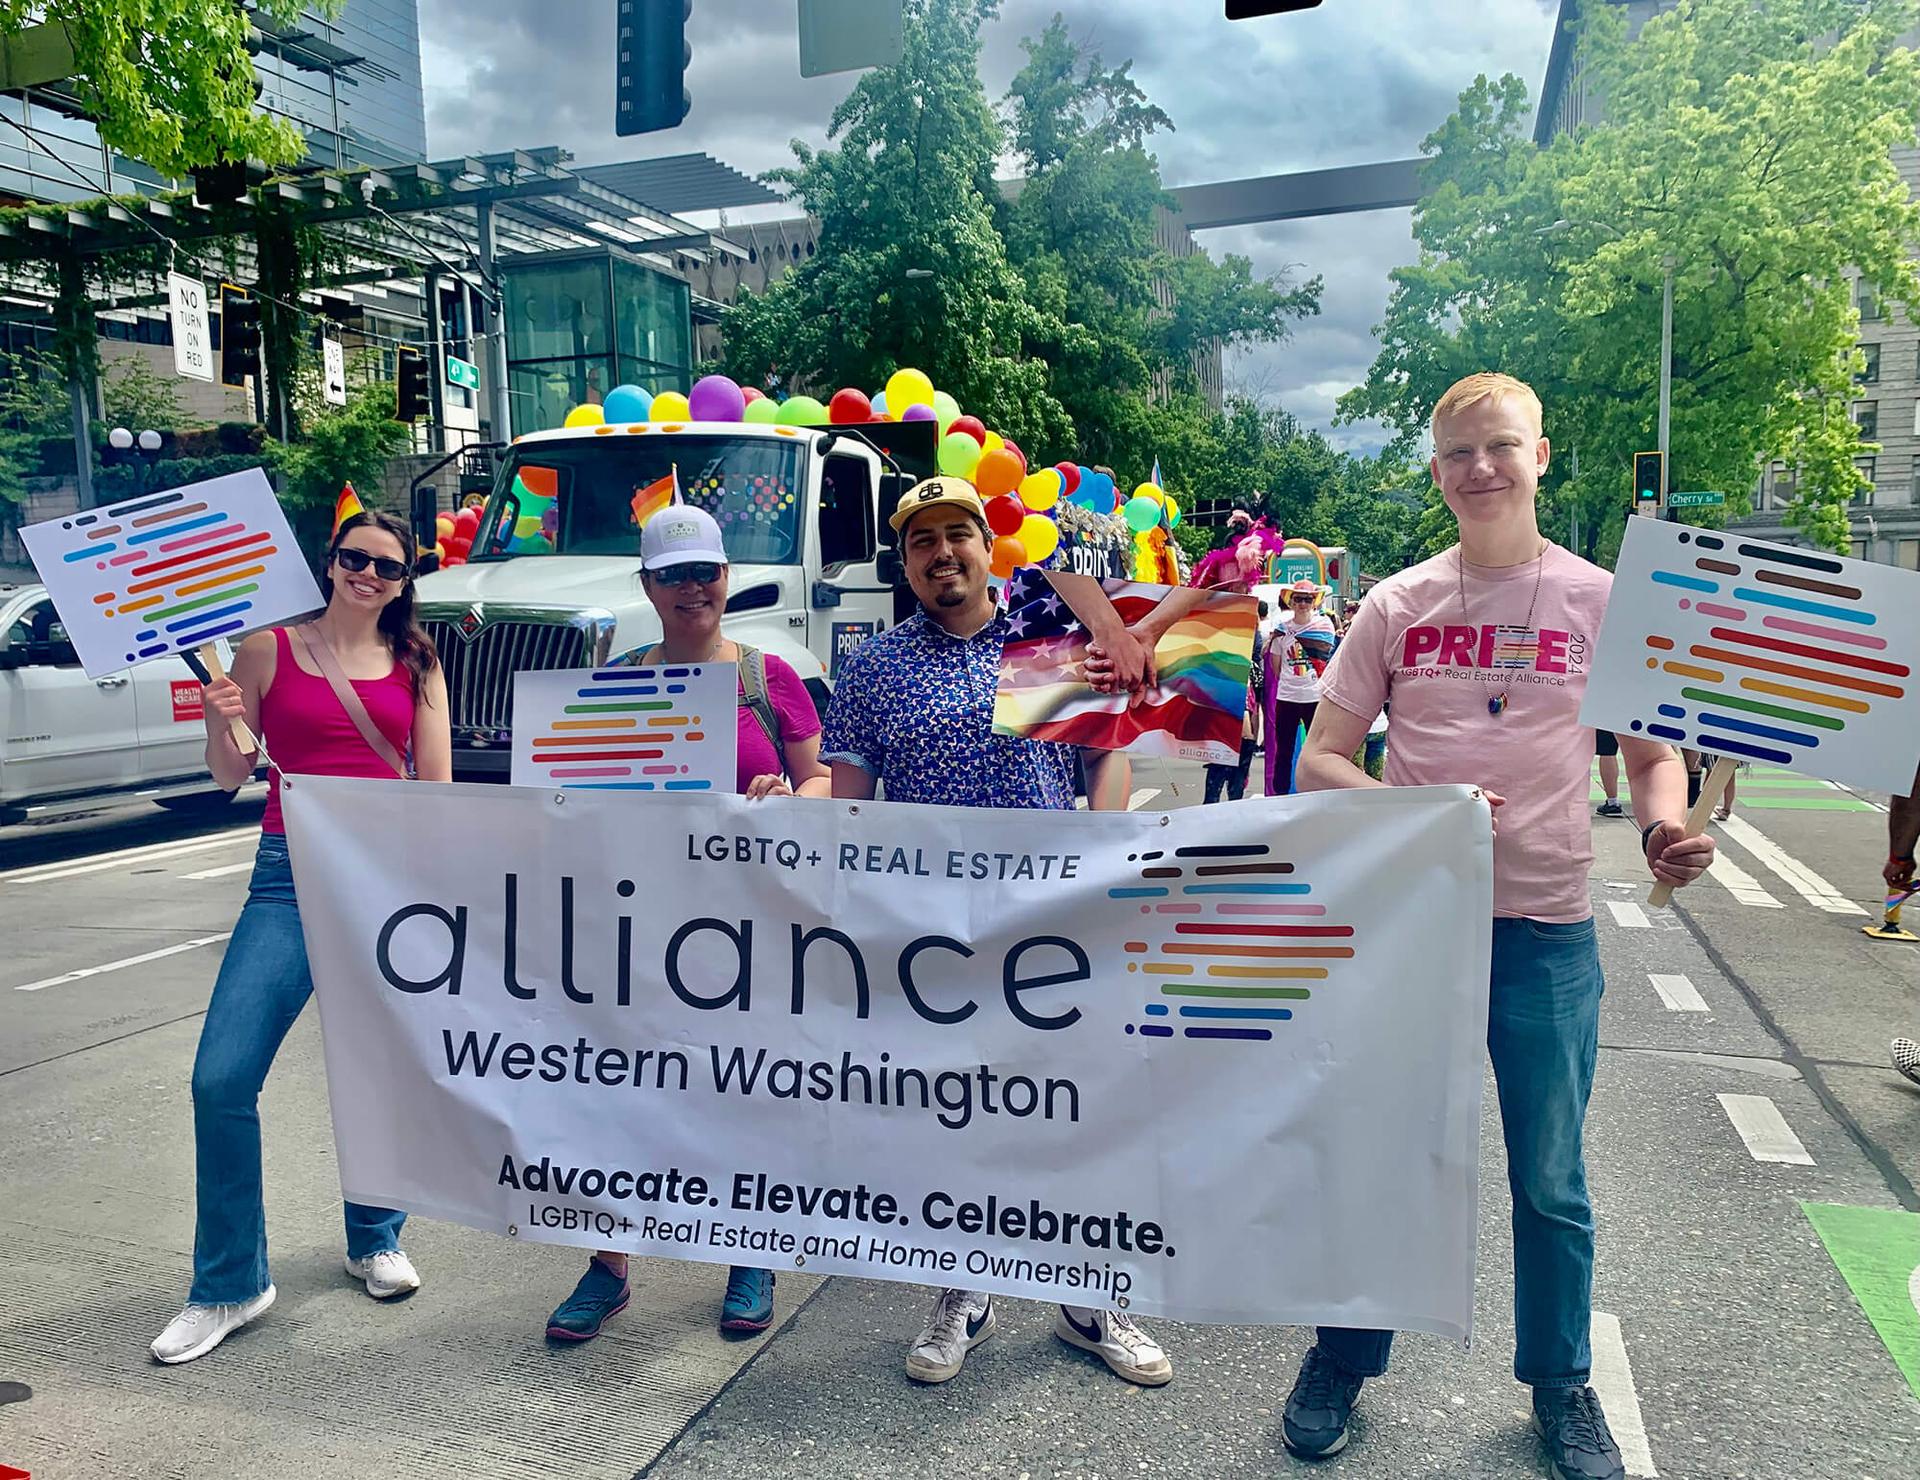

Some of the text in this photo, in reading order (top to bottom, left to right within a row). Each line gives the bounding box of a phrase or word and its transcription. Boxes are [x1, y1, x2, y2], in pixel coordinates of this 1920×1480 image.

[180, 288, 198, 309] NO
[180, 310, 201, 328] TURN
[187, 332, 199, 347] ON
[186, 351, 203, 367] RED
[1671, 494, 1704, 504] Cherry
[1288, 571, 1313, 584] ICE
[1567, 634, 1585, 675] 2024
[1444, 668, 1472, 681] Real
[1474, 671, 1513, 683] Estate
[1515, 673, 1565, 686] Alliance
[1179, 747, 1221, 760] alliance
[688, 834, 1082, 881] LGBTQ+ REAL ESTATE
[376, 872, 1091, 1031] alliance
[442, 1029, 1080, 1130] Western Washington
[497, 1153, 1176, 1259] Advocate. Elevate. Celebrate.
[529, 1203, 1133, 1303] LGBTQ+ Real Estate and Home Ownership
